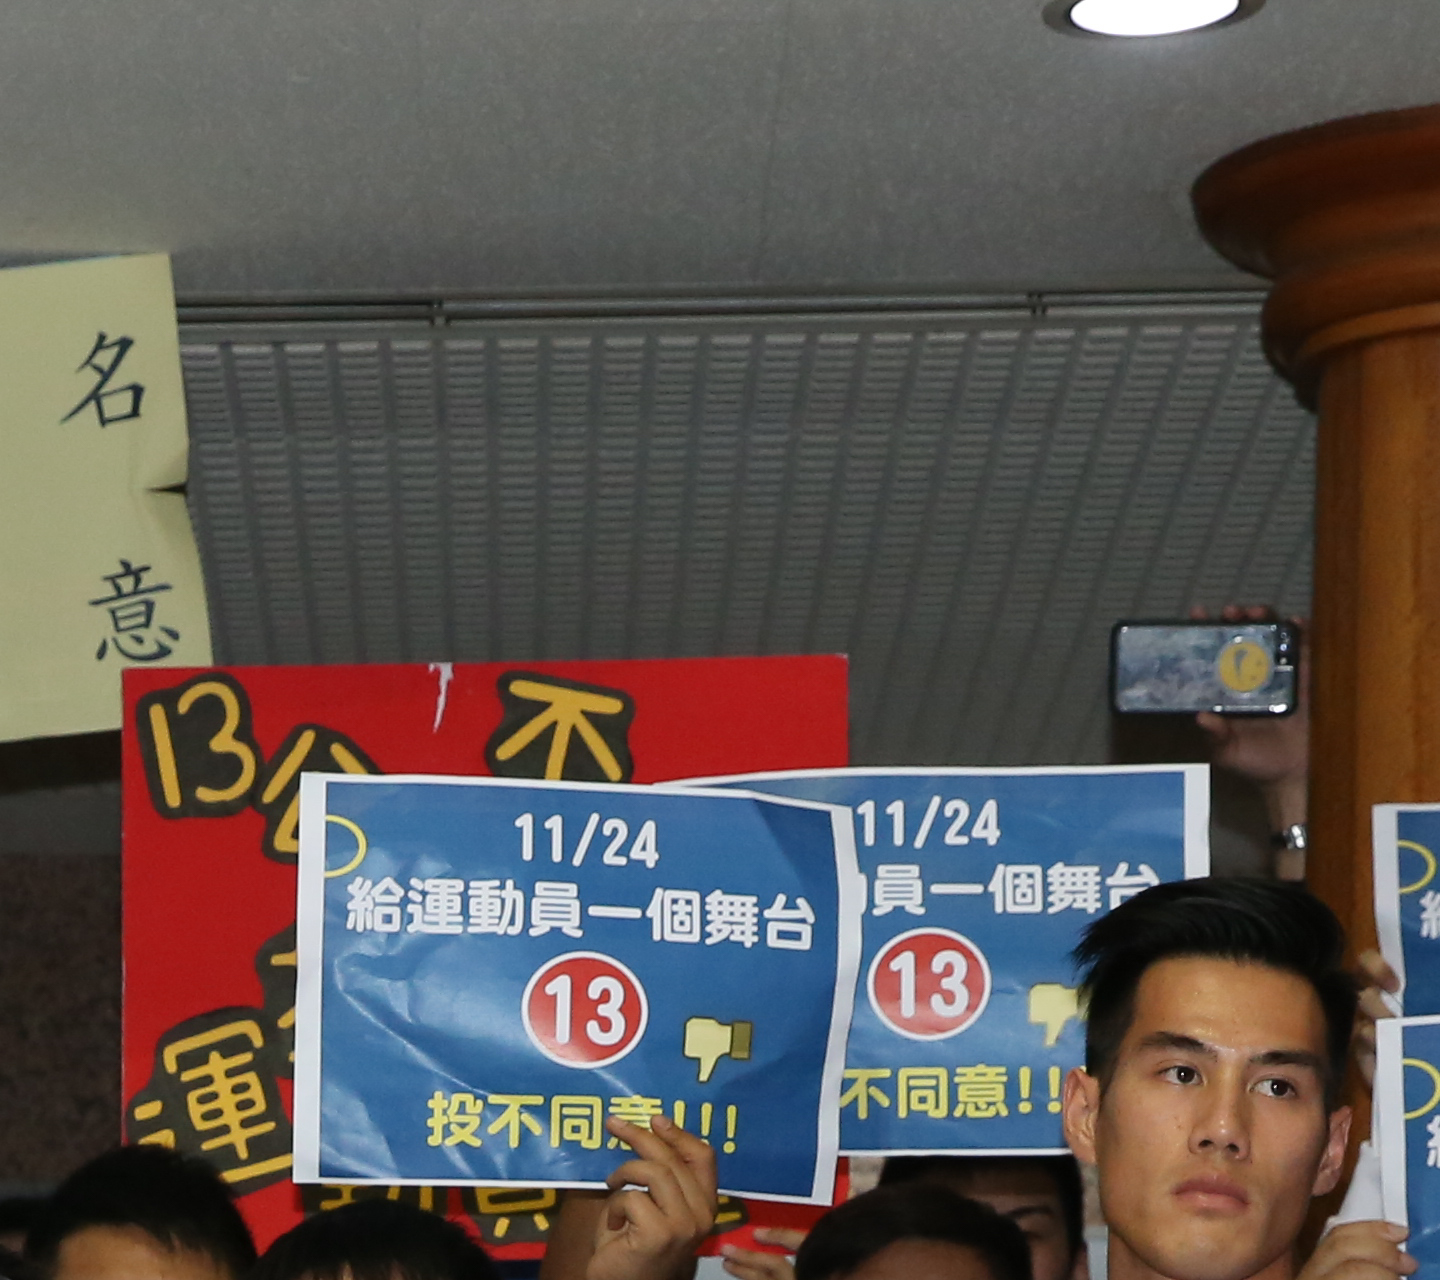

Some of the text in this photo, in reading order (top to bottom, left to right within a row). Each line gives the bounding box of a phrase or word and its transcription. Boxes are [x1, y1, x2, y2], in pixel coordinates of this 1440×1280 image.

[515, 813, 660, 869] 11/24
[857, 795, 1001, 849] 11/24
[345, 876, 816, 951] 給運動員一個舞台
[543, 974, 625, 1047] 13
[889, 949, 971, 1019] 13
